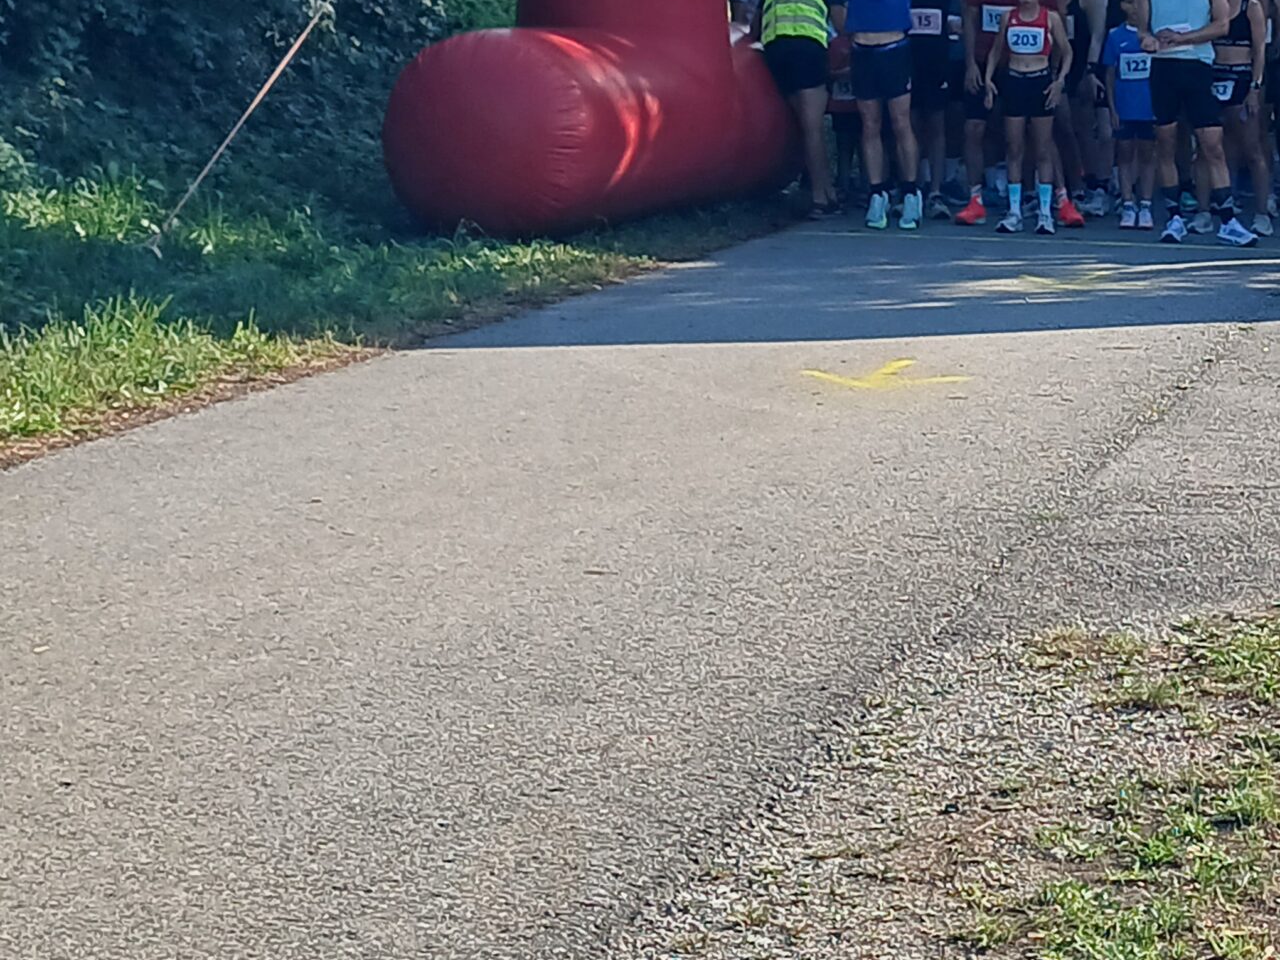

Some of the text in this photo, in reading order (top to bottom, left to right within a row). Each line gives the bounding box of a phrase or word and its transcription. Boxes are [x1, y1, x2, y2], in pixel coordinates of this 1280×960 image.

[918, 15, 932, 27] 15
[1011, 33, 1038, 46] 203
[1125, 60, 1148, 72] 122
